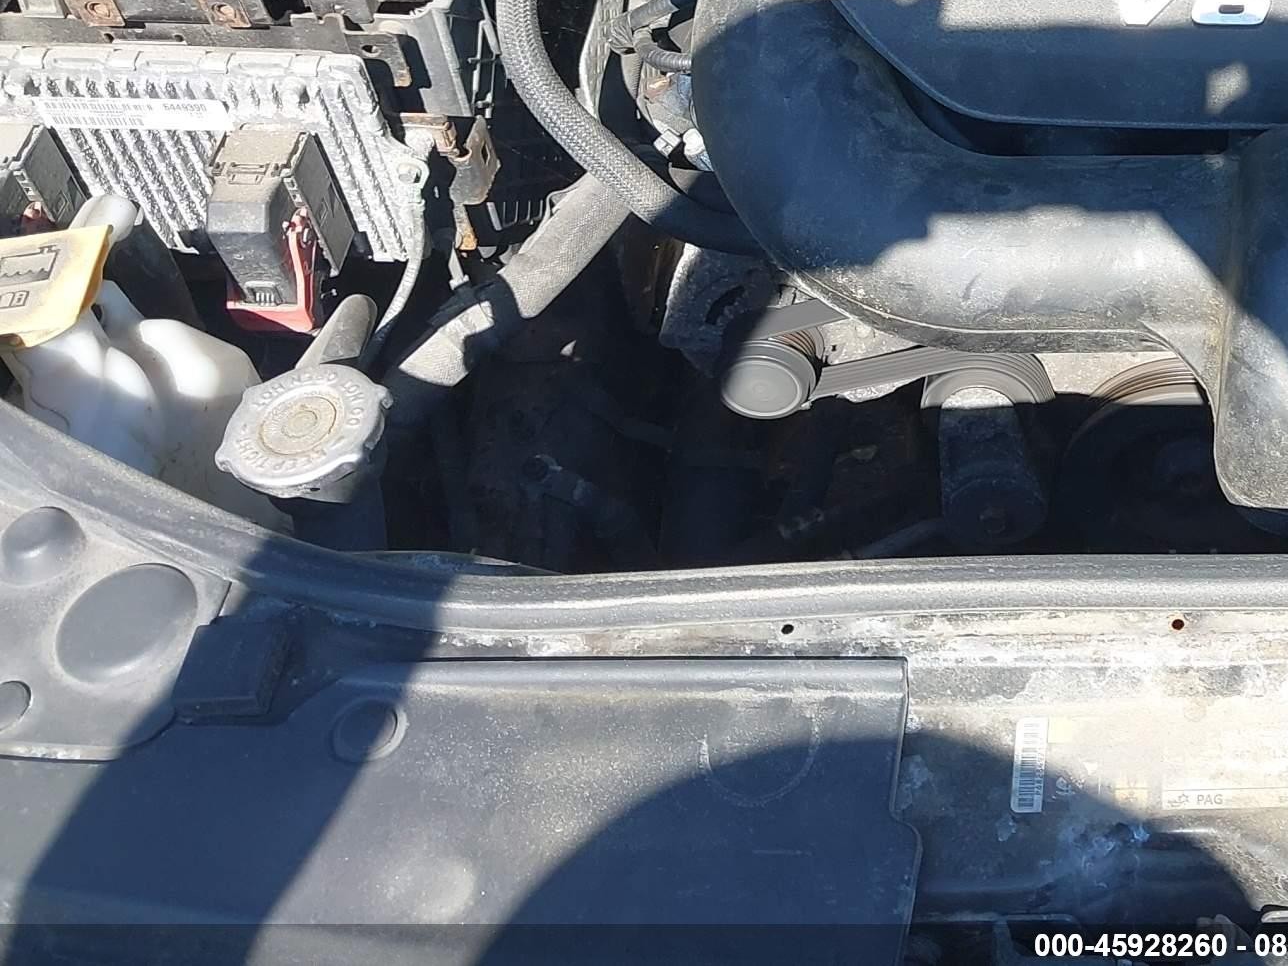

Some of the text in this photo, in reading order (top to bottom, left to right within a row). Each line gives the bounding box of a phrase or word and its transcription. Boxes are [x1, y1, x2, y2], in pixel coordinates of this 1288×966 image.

[253, 382, 286, 409] HOT
[342, 383, 365, 403] NOT
[236, 436, 327, 472] KEEP TIGHT
[1196, 793, 1223, 805] PAG
